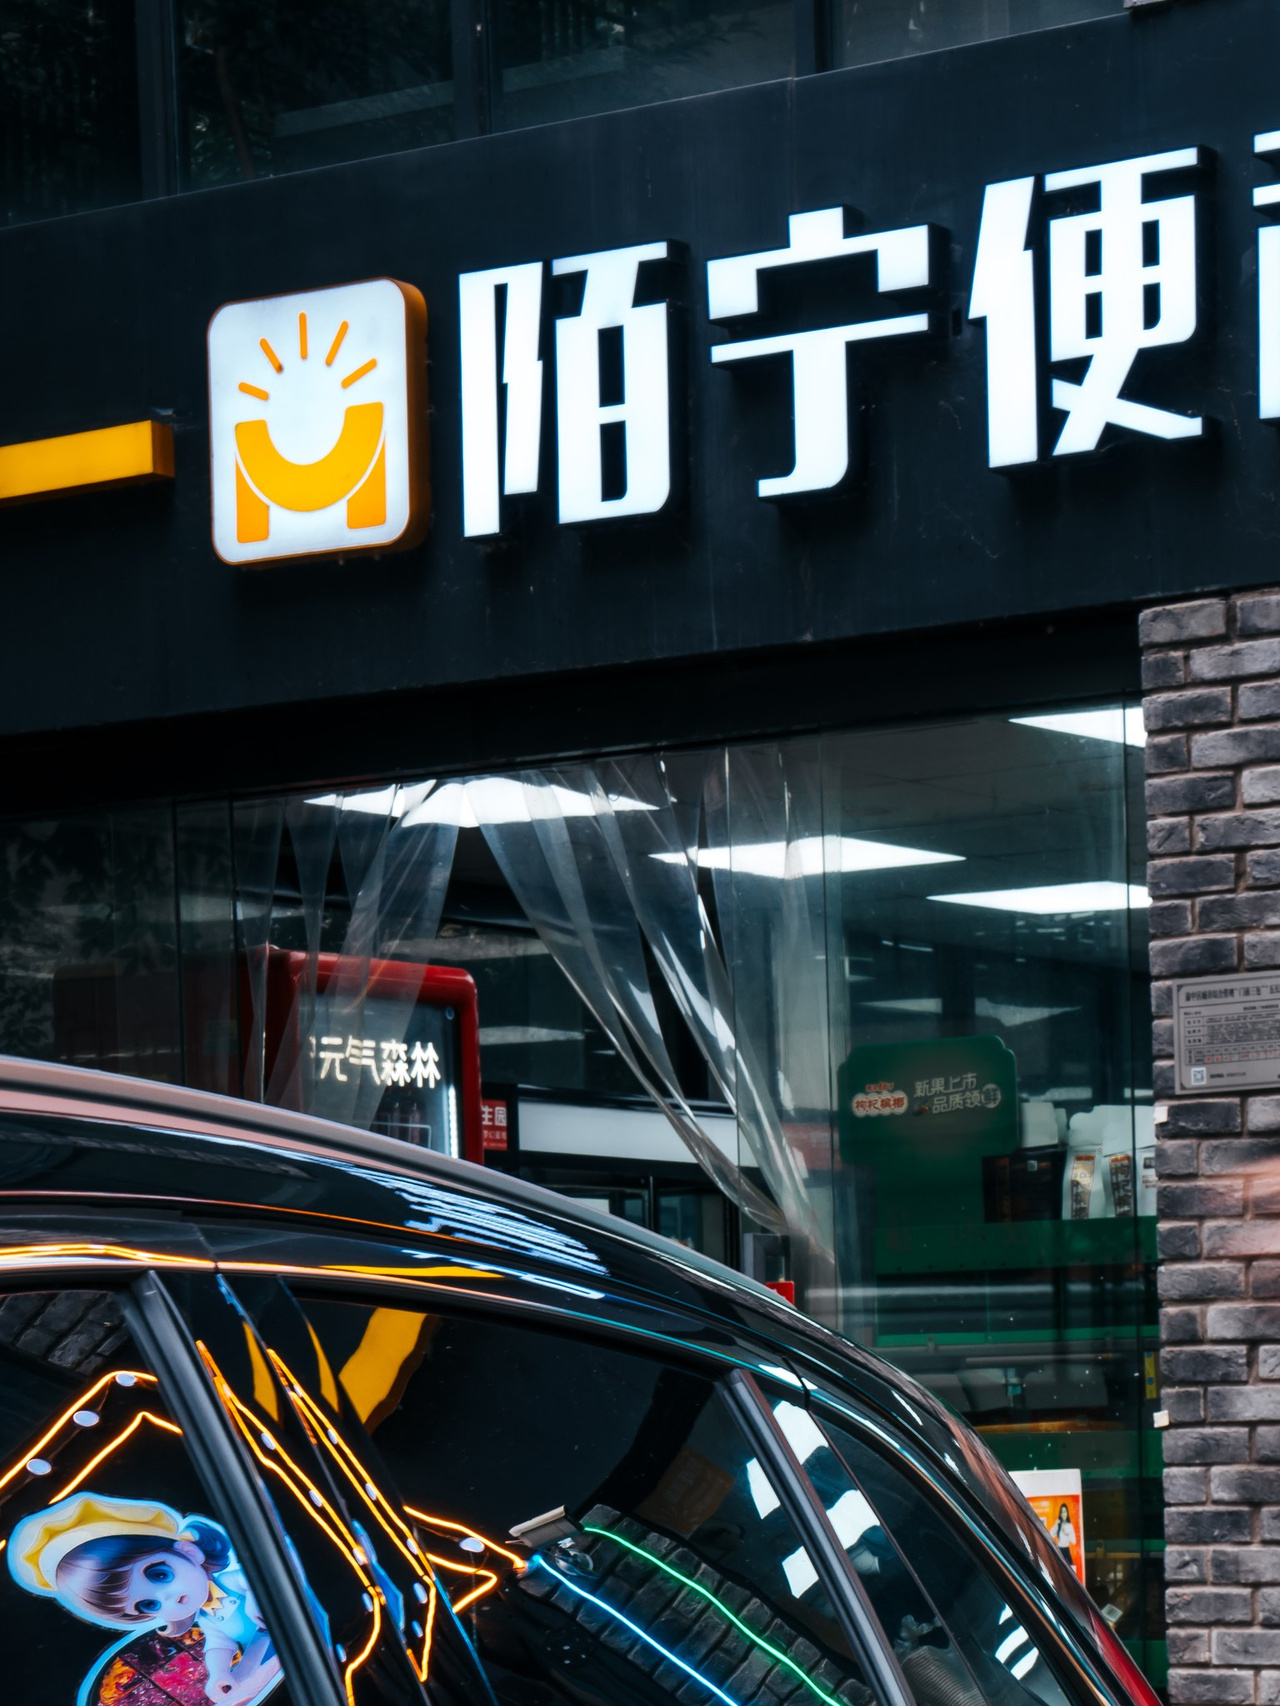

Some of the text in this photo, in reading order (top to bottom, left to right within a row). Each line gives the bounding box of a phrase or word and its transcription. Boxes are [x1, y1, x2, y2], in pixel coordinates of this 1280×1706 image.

[319, 1035, 442, 1089] 元气森林
[914, 1072, 977, 1098] 新果上市
